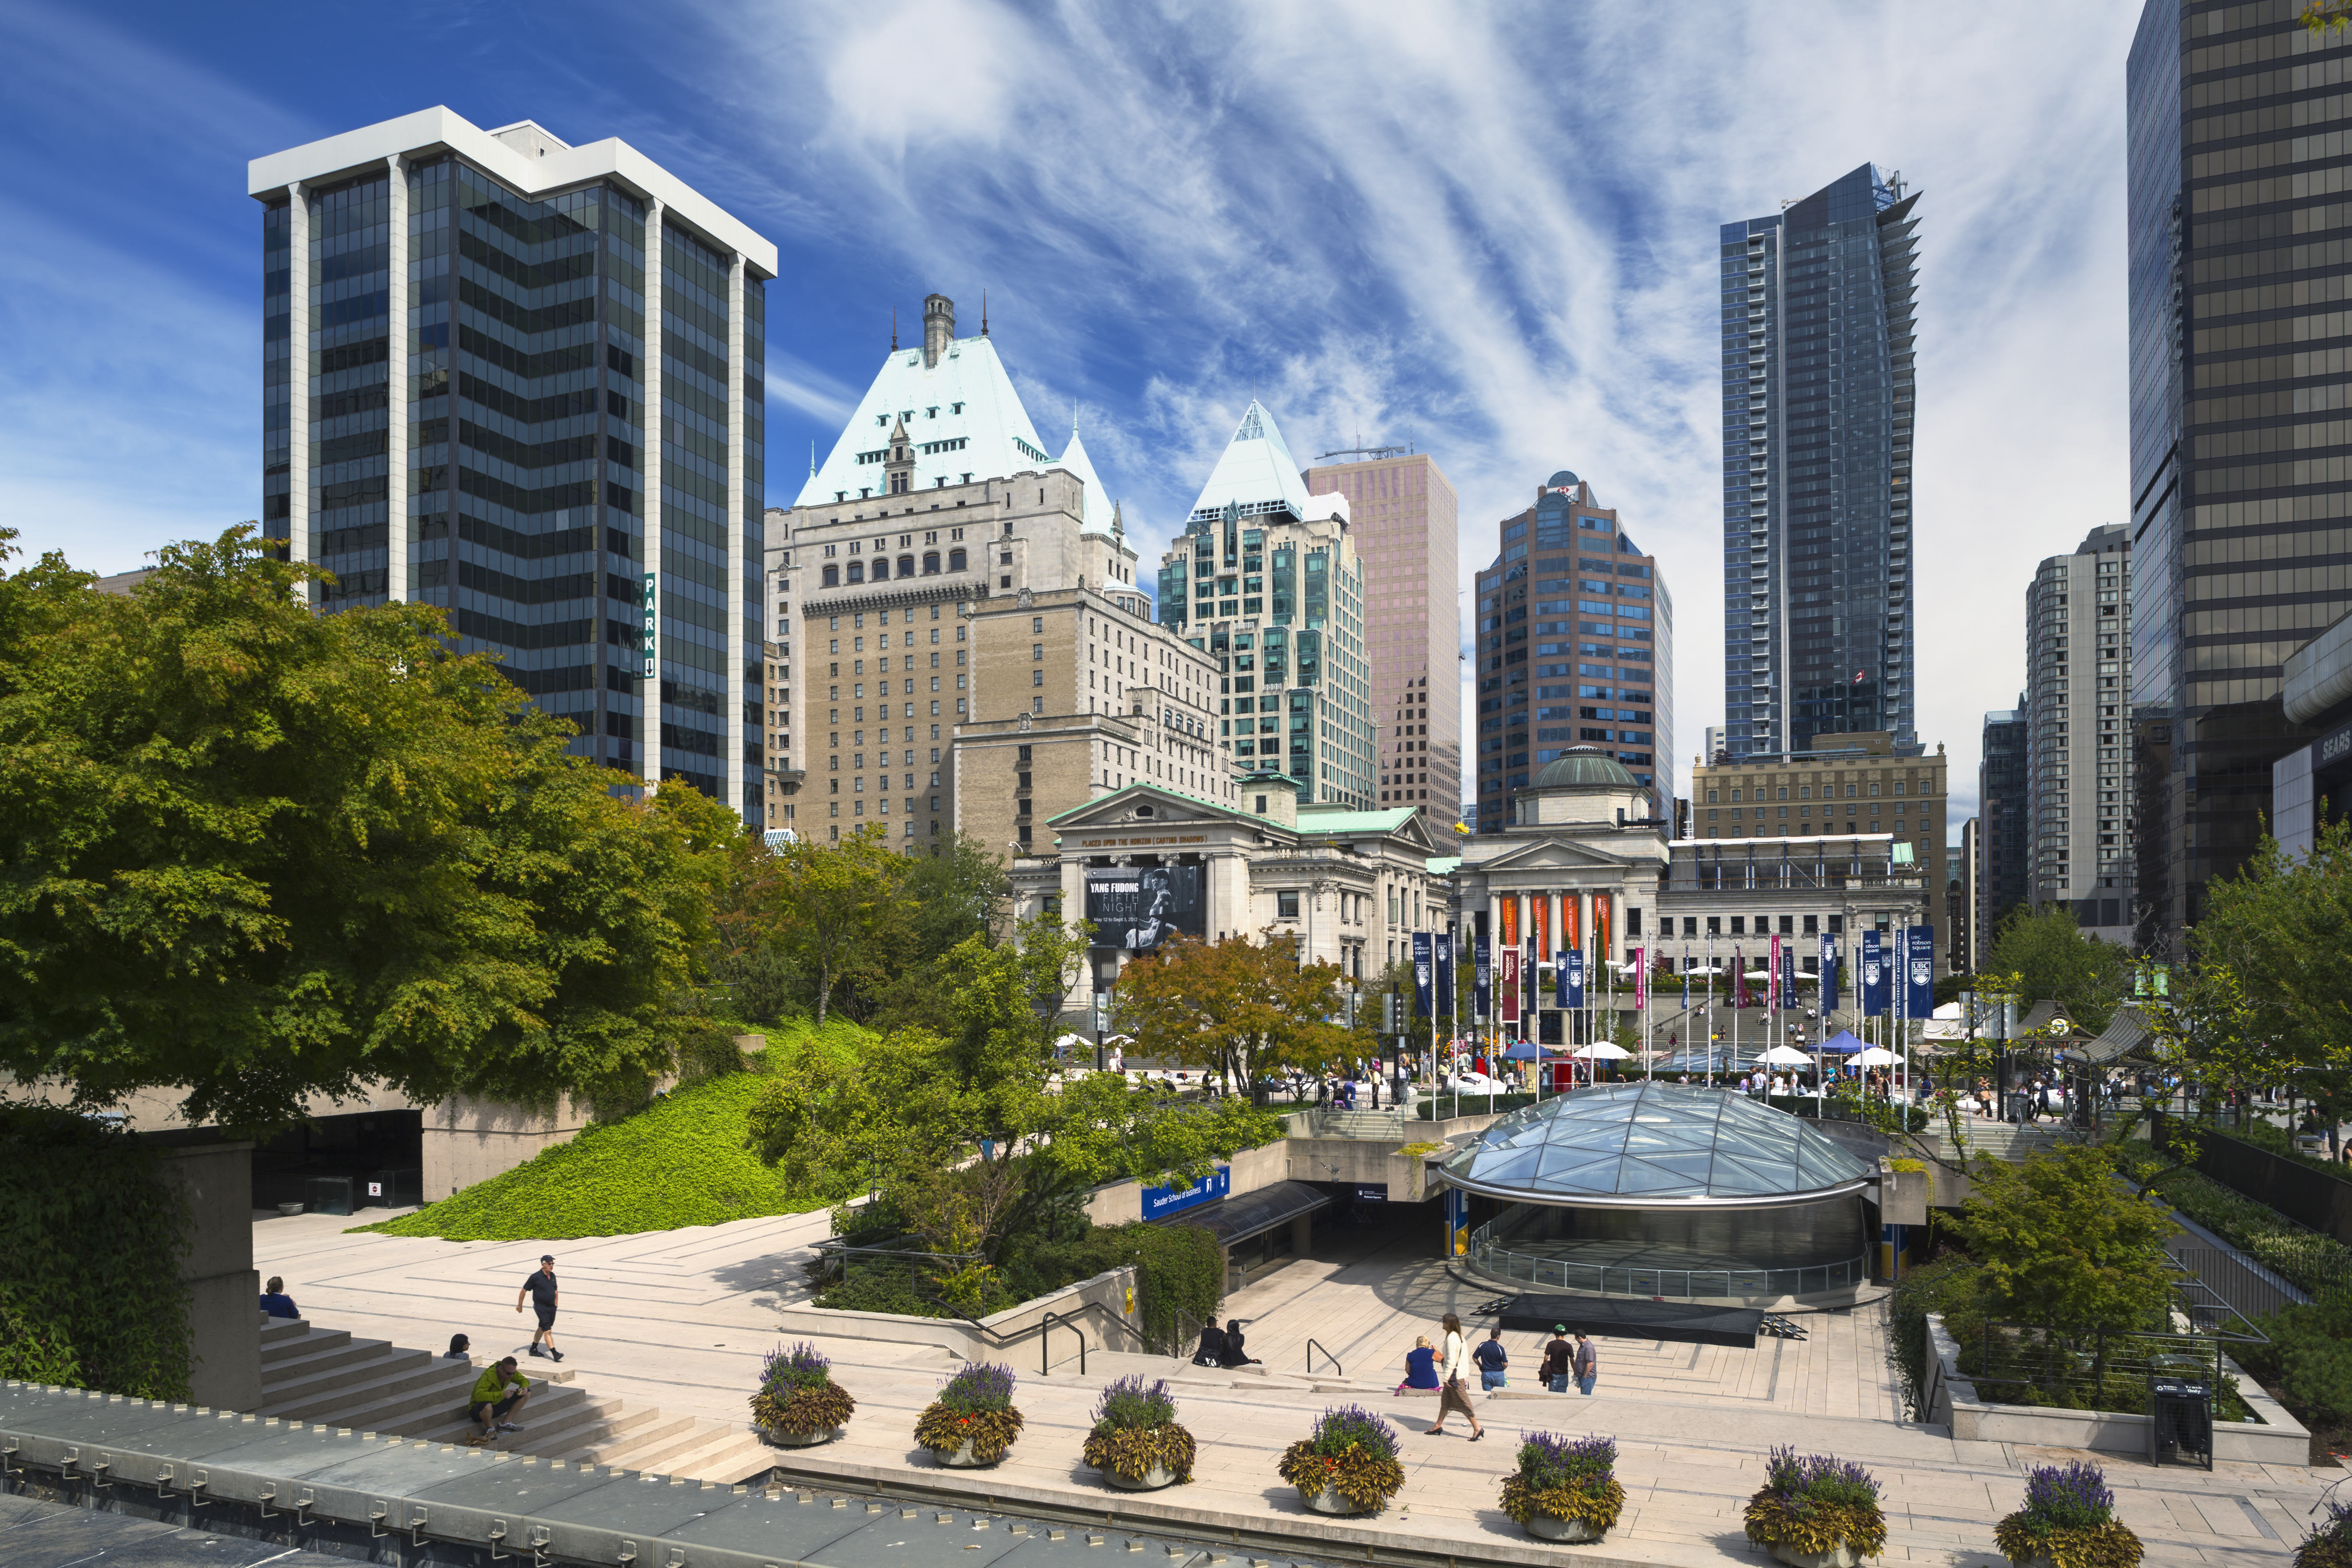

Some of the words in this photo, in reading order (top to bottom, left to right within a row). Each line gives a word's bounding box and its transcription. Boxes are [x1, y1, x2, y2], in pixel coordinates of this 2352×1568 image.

[645, 579, 654, 650] PARK
[2323, 730, 2350, 760] SEARS
[1090, 883, 1109, 893] YANG
[1111, 883, 1139, 893] FUDONG
[1103, 893, 1138, 902] FIFTH
[1103, 902, 1138, 912] NIGHT
[1154, 1197, 1168, 1207] Sauder
